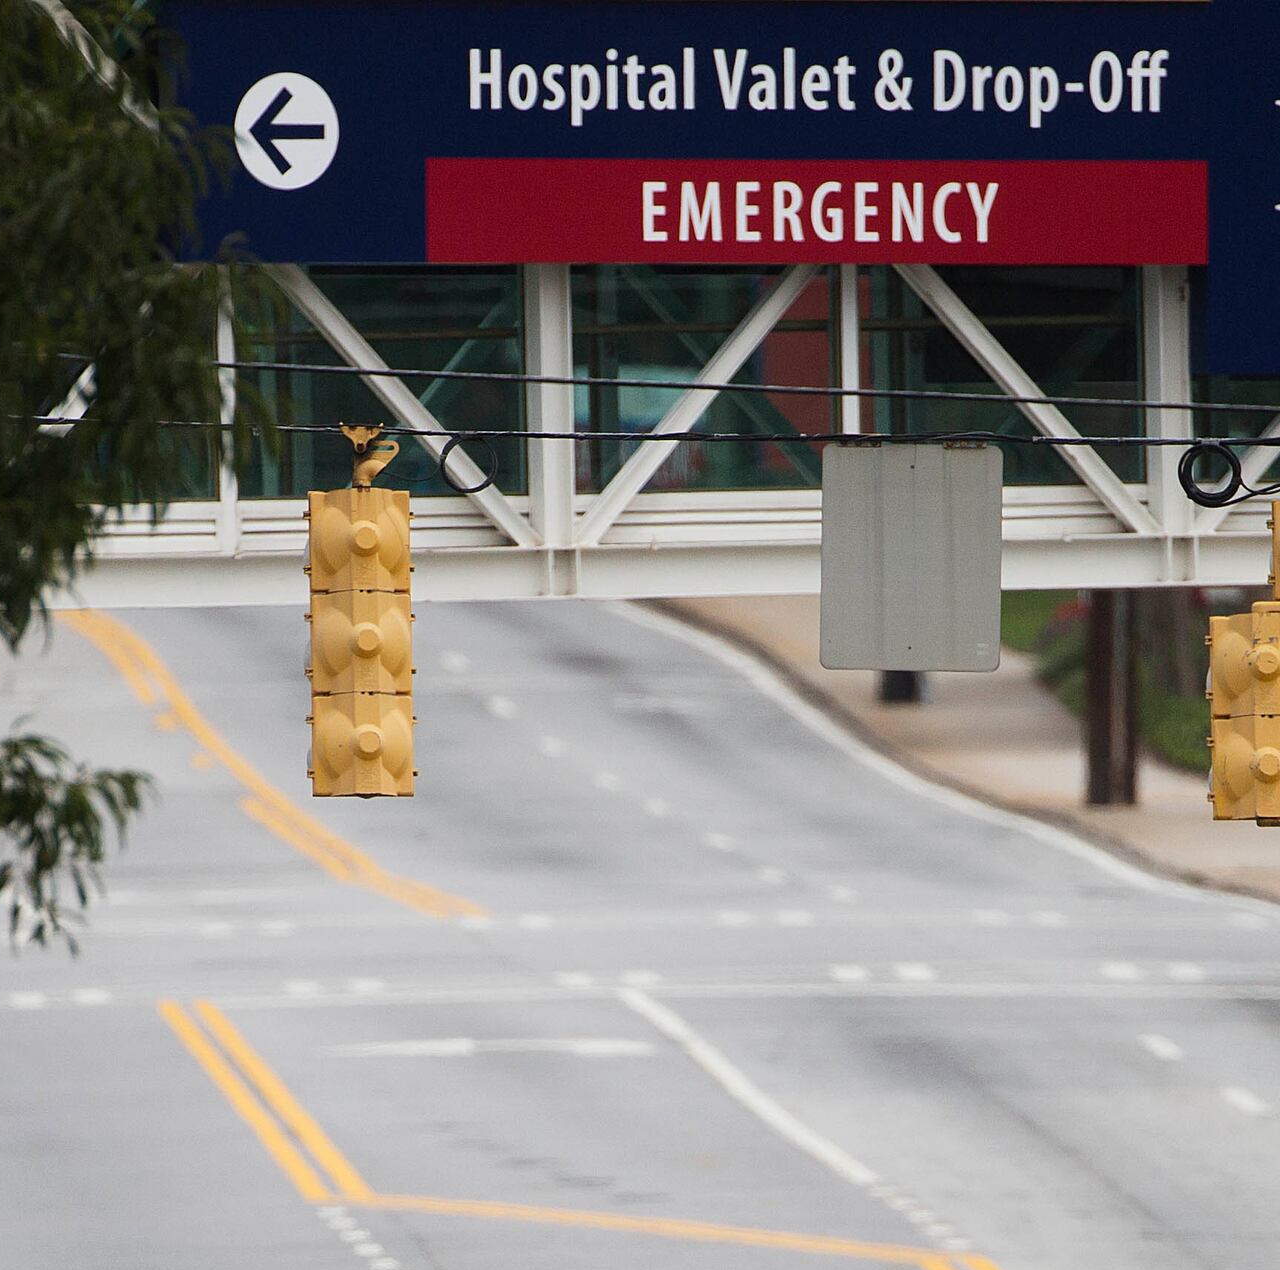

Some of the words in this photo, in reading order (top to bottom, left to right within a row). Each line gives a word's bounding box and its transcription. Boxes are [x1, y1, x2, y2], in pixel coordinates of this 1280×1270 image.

[469, 47, 695, 127] Hospital
[713, 47, 857, 111] Valet
[874, 48, 913, 112] &
[933, 49, 1170, 129] Drop-Off
[642, 180, 999, 243] EMERGENCY
